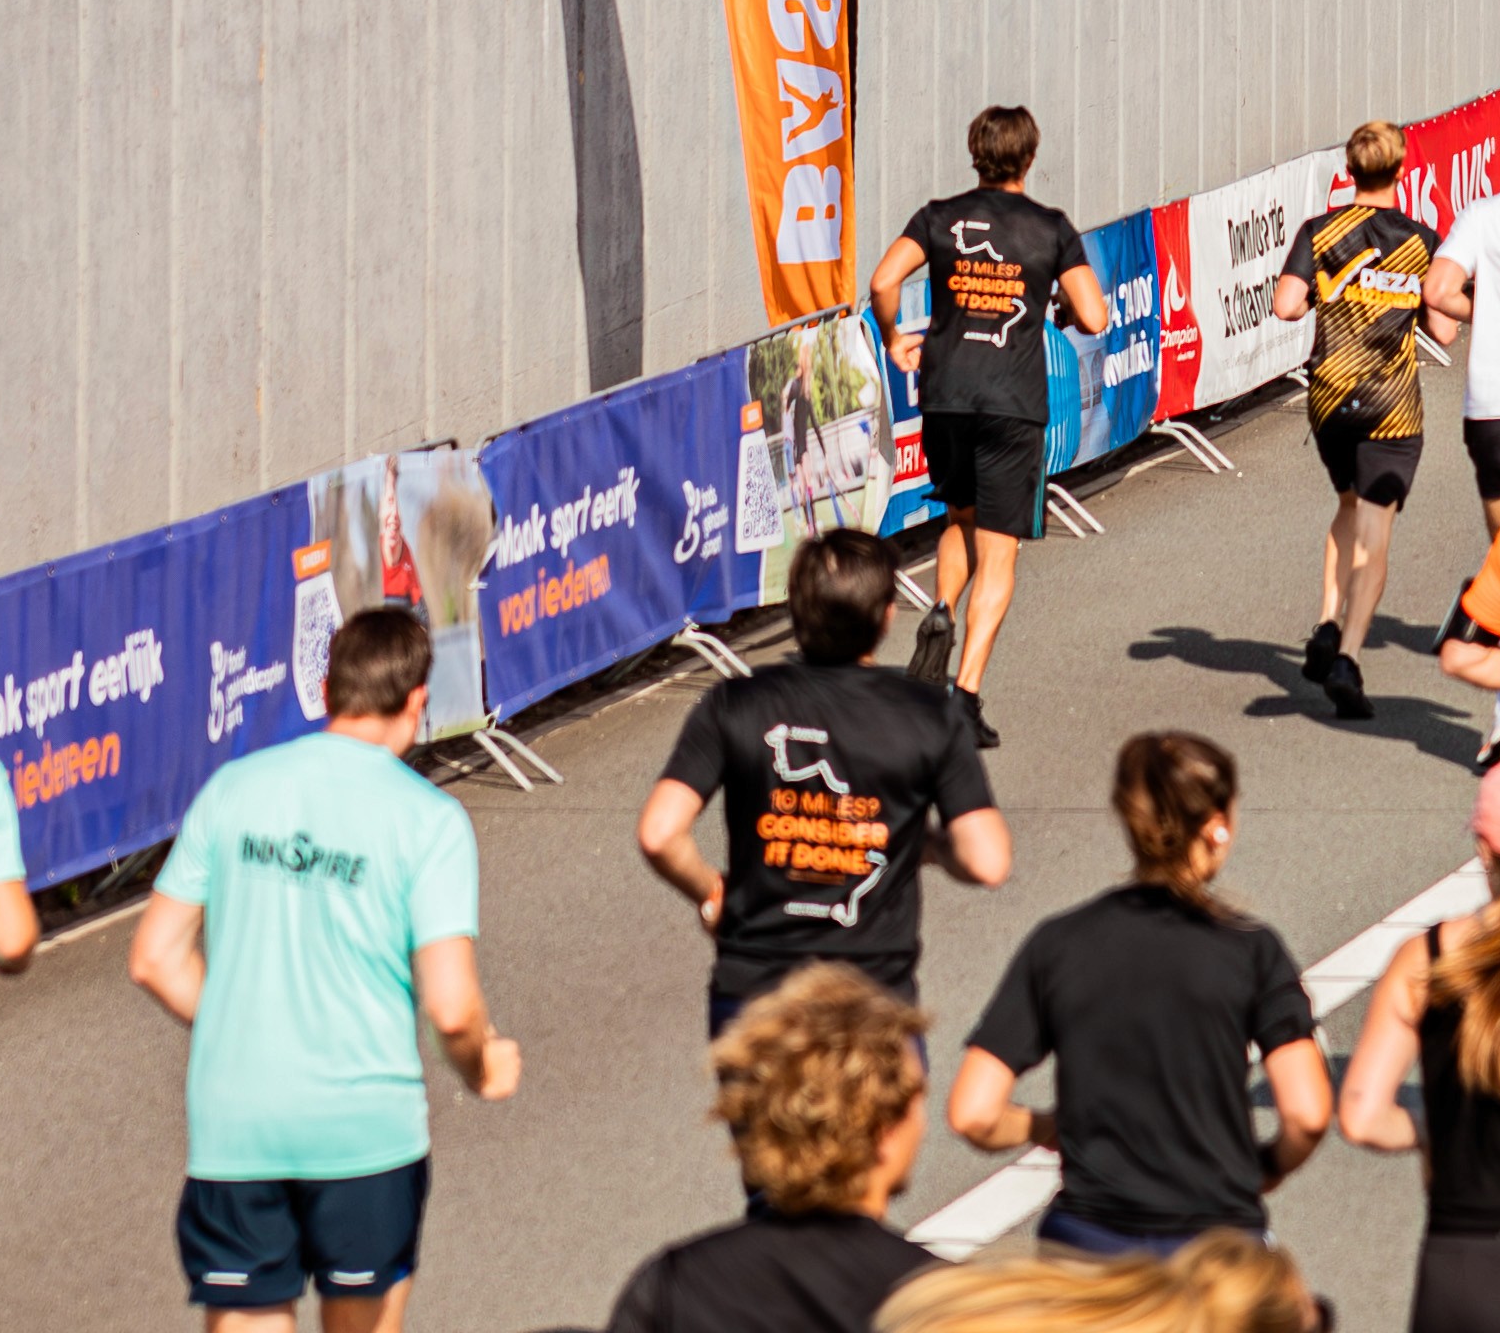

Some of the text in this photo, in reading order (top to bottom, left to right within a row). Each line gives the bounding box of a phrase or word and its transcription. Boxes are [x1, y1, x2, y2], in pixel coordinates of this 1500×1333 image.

[955, 260, 1022, 277] 10 MILES?
[1360, 267, 1422, 294] DEZA
[948, 275, 1025, 296] CONSIDER
[590, 466, 640, 530] eerijk
[26, 651, 86, 739] sport
[89, 629, 164, 707] eerlijk
[771, 789, 880, 820] 10 MILES?
[757, 814, 889, 849] CONSIDER
[764, 841, 788, 868] IT
